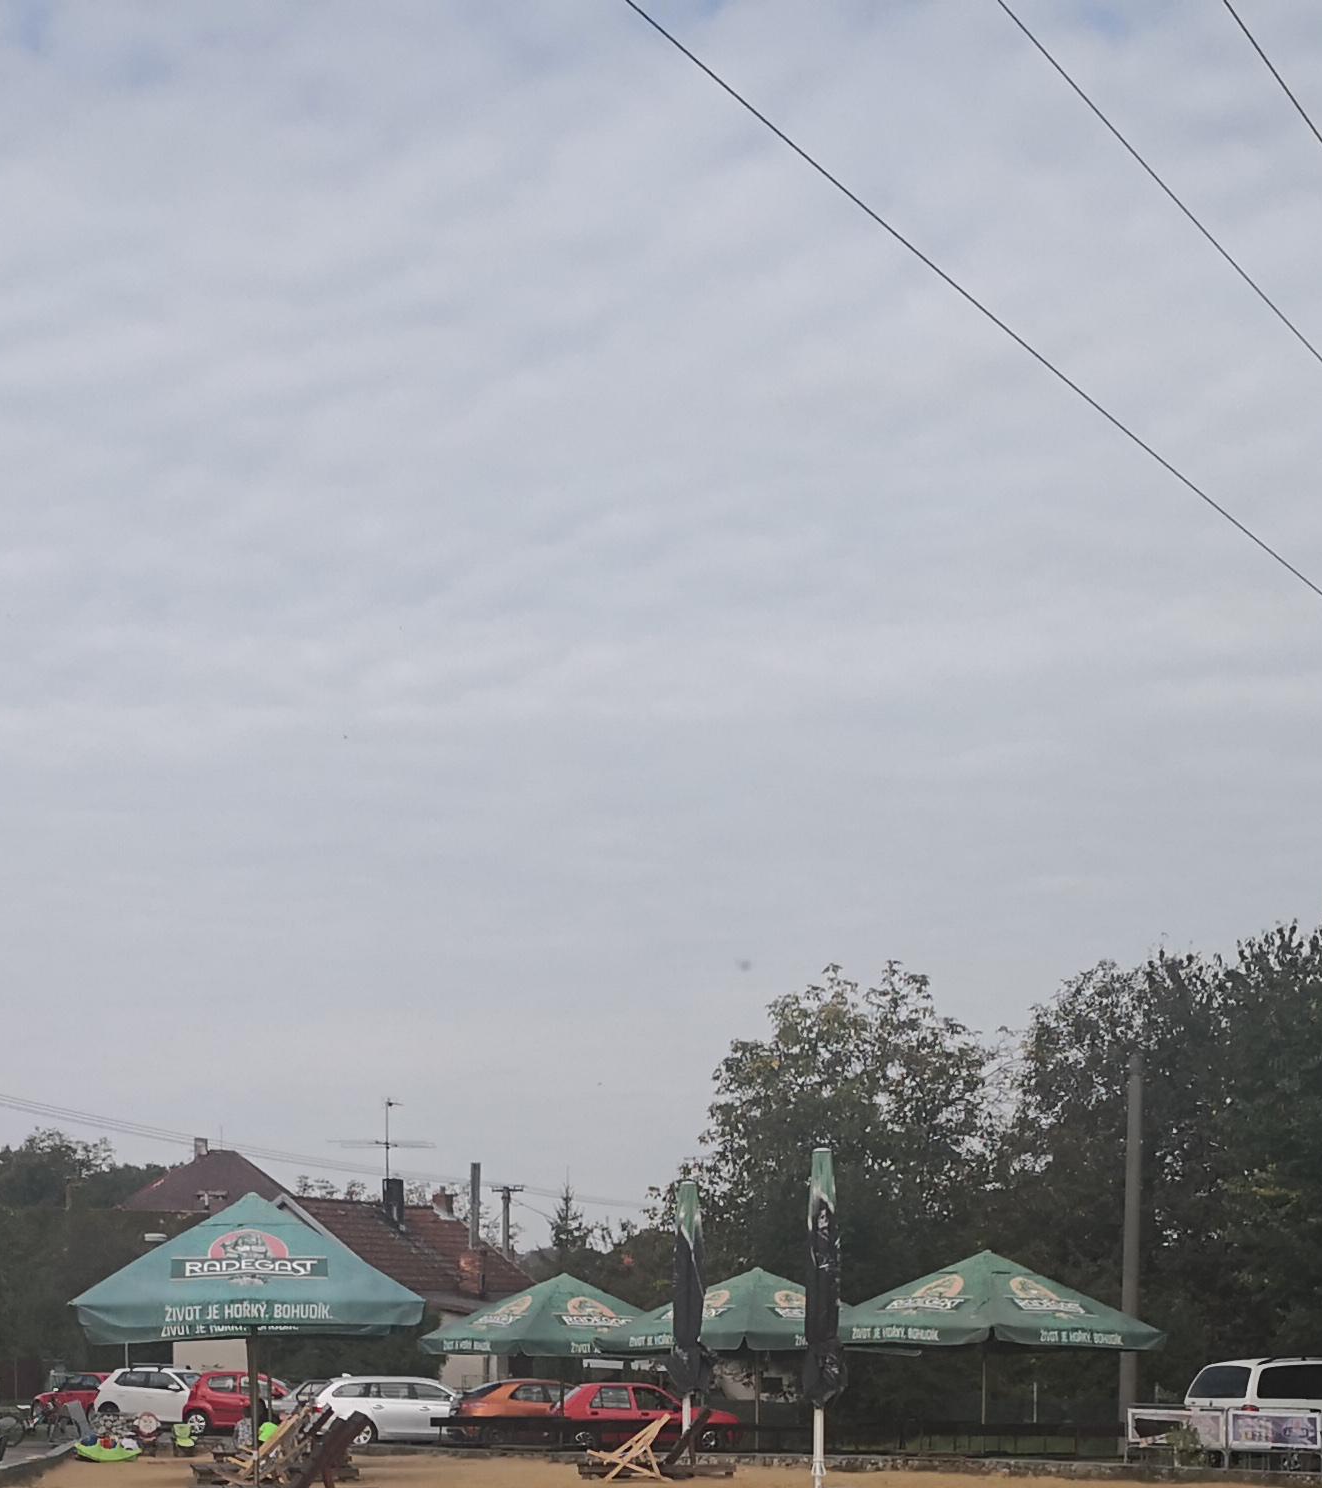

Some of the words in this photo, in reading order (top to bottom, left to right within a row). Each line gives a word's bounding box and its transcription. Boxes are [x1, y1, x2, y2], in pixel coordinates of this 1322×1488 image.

[185, 1259, 317, 1277] RADEGAST
[164, 1304, 202, 1321] ŽIVOT
[206, 1304, 220, 1320] JE
[224, 1301, 269, 1319] HOŘKÝ.
[273, 1302, 333, 1320] BOHUDÍK.
